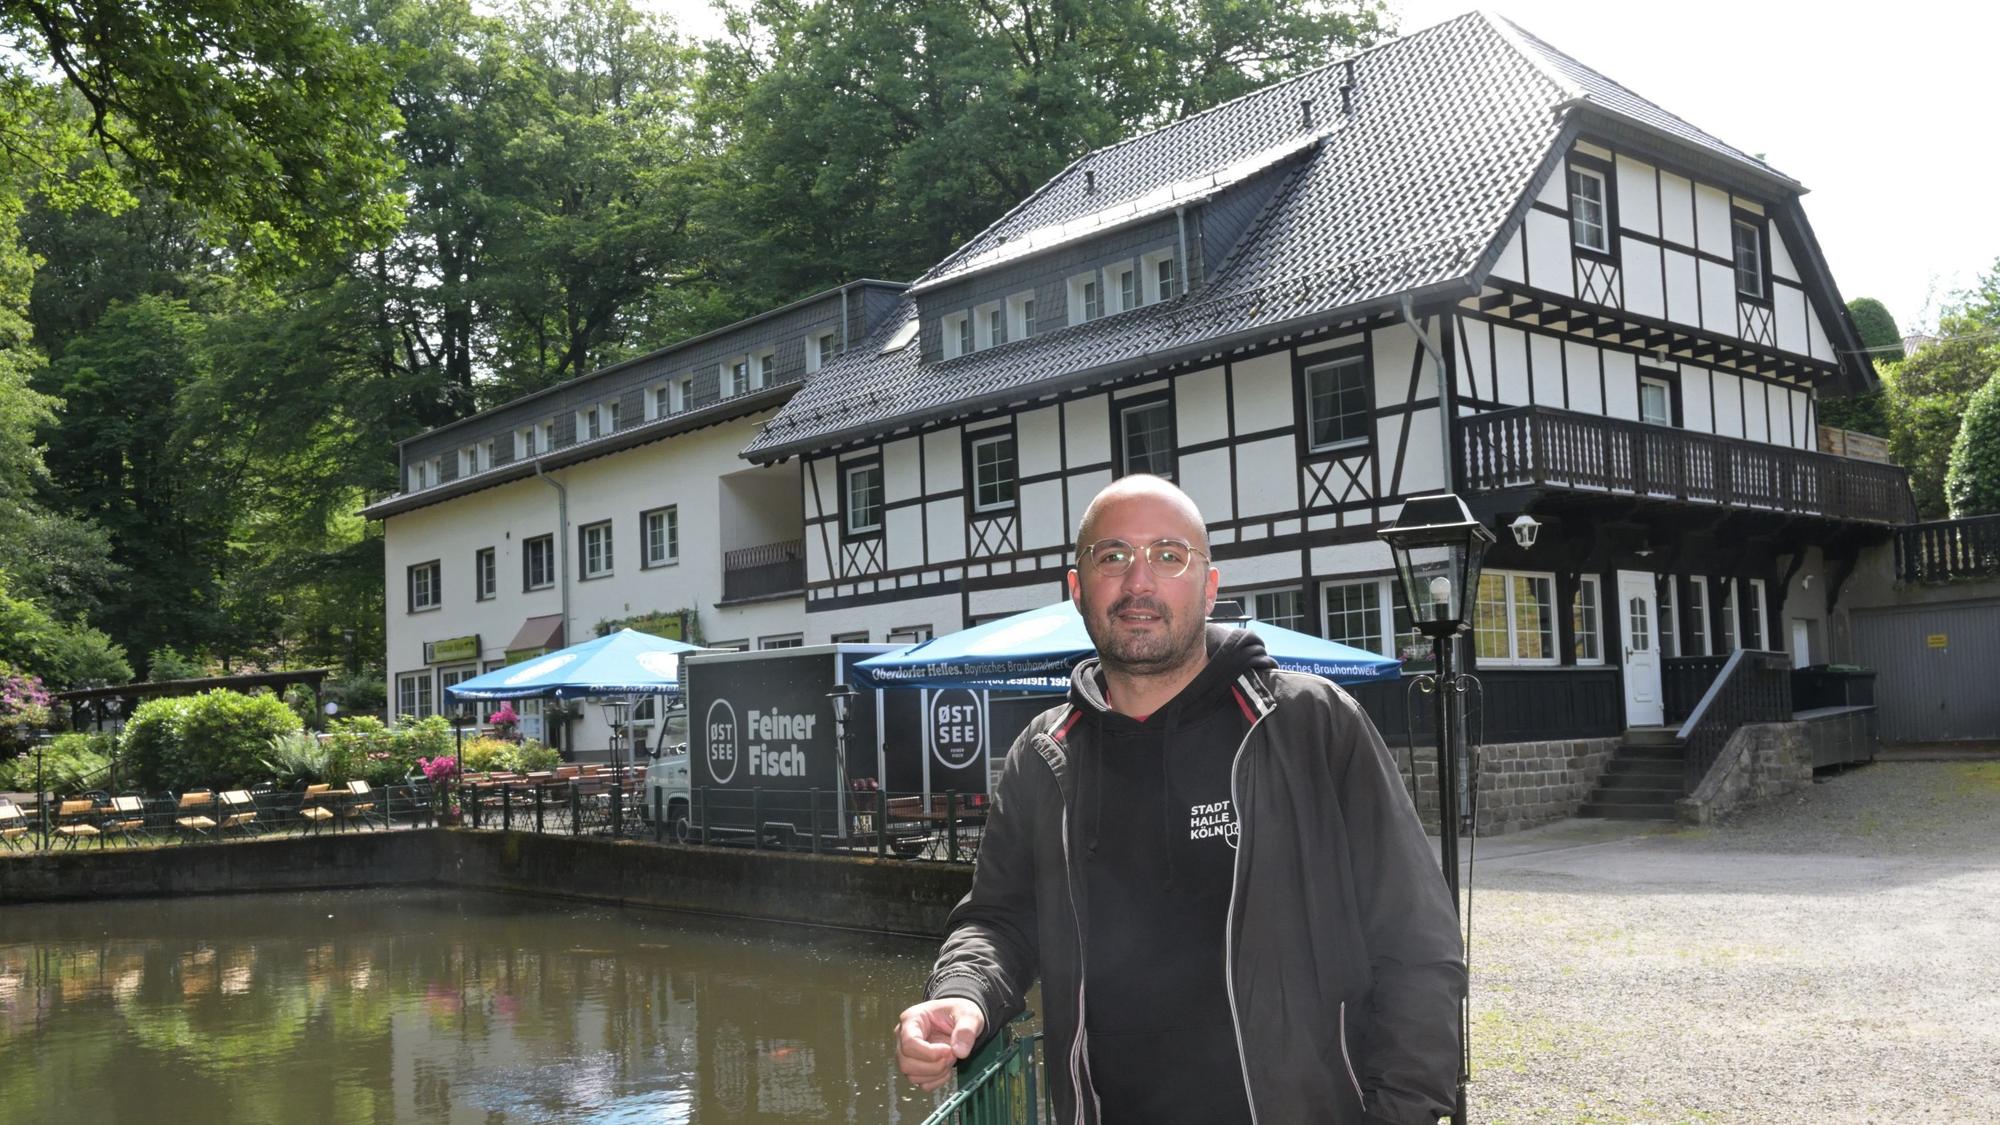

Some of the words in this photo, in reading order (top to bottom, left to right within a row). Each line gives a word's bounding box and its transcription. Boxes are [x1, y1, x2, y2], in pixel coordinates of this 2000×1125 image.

[872, 665, 926, 680] Oberdorfer
[928, 662, 963, 677] Helles.
[964, 662, 1006, 676] Bayrisches
[1280, 662, 1312, 673] risches
[938, 704, 974, 725] ØST
[748, 707, 816, 740] Feiner
[711, 723, 732, 742] ØST
[940, 726, 974, 743] SEE
[711, 743, 733, 760] SEE
[749, 743, 806, 777] Fisch
[1191, 800, 1230, 815] STADT
[1190, 812, 1230, 827] HALLE
[1190, 825, 1224, 840] KÖLN
